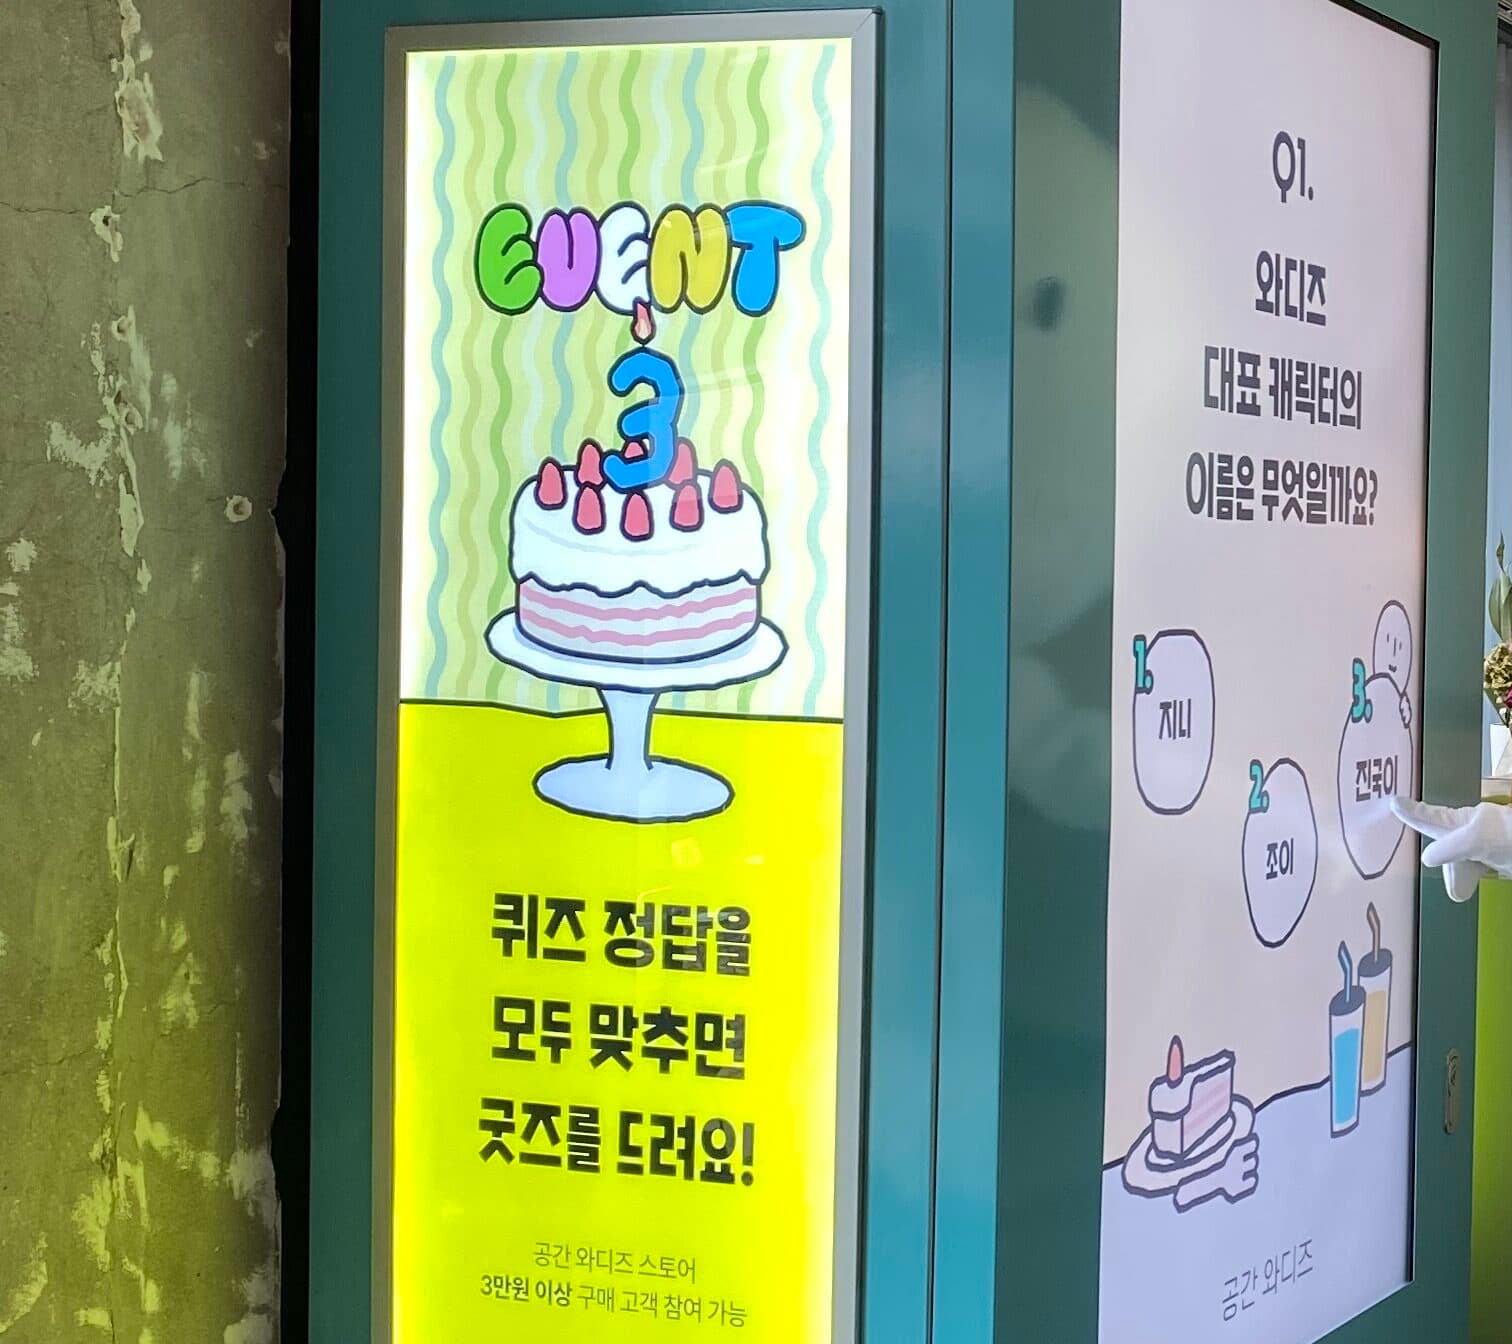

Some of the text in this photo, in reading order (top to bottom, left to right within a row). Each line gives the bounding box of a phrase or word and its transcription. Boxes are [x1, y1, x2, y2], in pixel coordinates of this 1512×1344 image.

[1272, 131, 1314, 203] Q1.
[474, 201, 807, 317] EVENT
[1255, 250, 1326, 326] 와디즈
[1204, 345, 1362, 430] 대표 캐릭터의
[1185, 451, 1378, 526] 이름은 무엇일까요?
[1158, 698, 1192, 740] 지니
[1355, 755, 1399, 803] 진국이
[1266, 837, 1294, 879] 조이
[491, 892, 751, 977] 퀴즈 정답을
[491, 996, 746, 1080] 모두 맞추면
[478, 1096, 755, 1187] 굿즈를 드려요!
[533, 1242, 697, 1284] 공간 와디즈 스토어
[1222, 1238, 1313, 1321] 공간 와디즈
[480, 1275, 748, 1327] 3만원 이상 구매 고객 참여 가능
